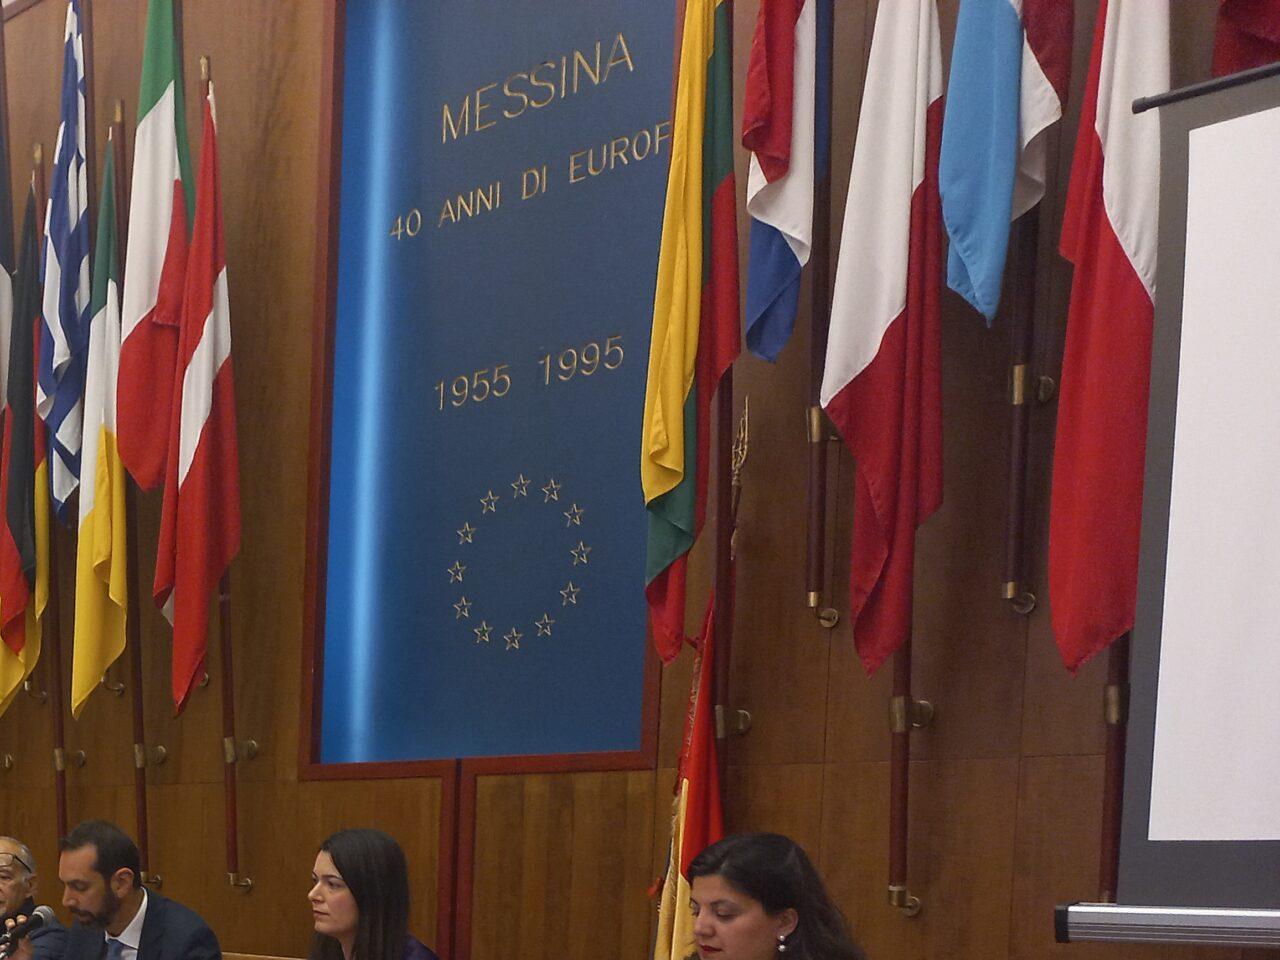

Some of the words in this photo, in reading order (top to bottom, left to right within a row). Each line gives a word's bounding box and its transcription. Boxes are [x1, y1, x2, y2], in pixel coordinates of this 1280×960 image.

[441, 32, 634, 145] MESSINA
[389, 207, 422, 241] 40
[438, 180, 502, 228] ANNI
[521, 165, 548, 200] DI
[434, 363, 512, 411] 1955
[538, 335, 625, 386] 1995
